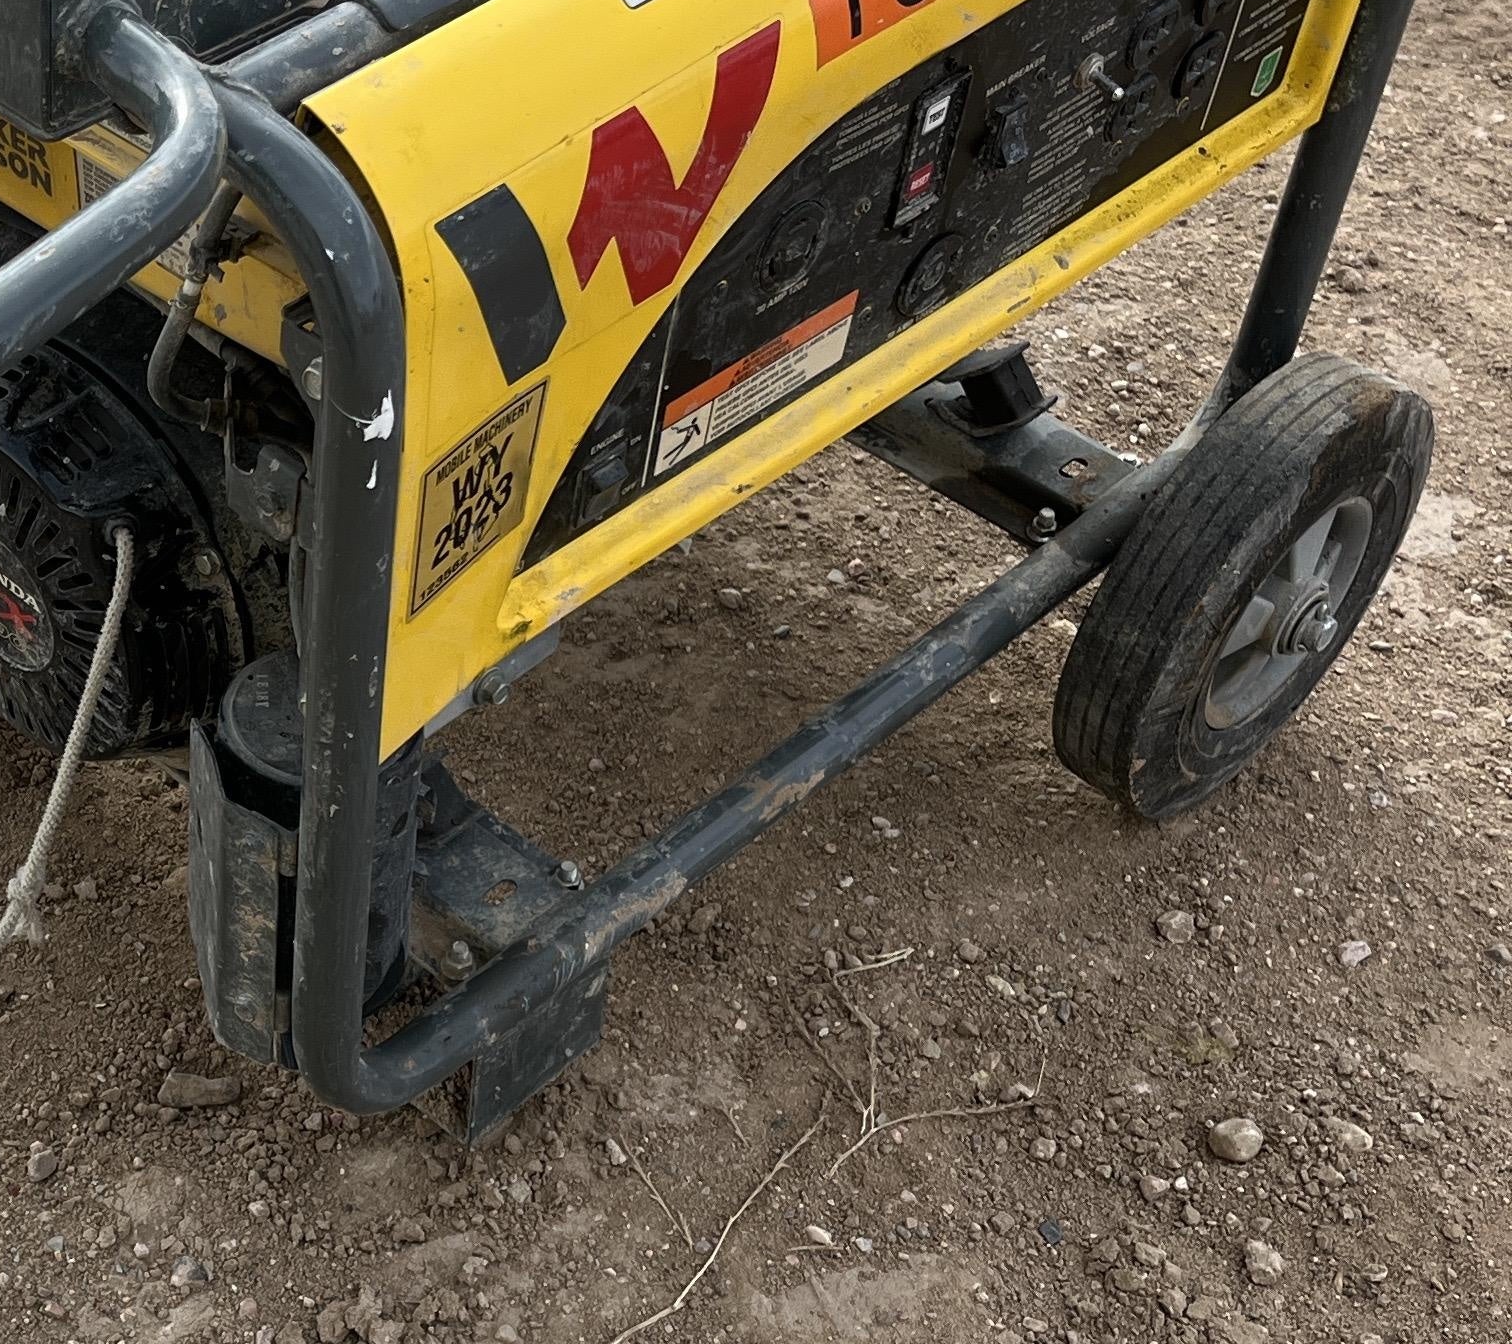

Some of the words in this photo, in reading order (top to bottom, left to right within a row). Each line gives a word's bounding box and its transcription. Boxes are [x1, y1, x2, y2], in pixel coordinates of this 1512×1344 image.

[435, 444, 473, 486] MOBILE
[473, 395, 534, 455] MACHINERY
[451, 431, 515, 508] WY
[590, 427, 624, 455] ENGINE
[430, 472, 514, 571] 2023
